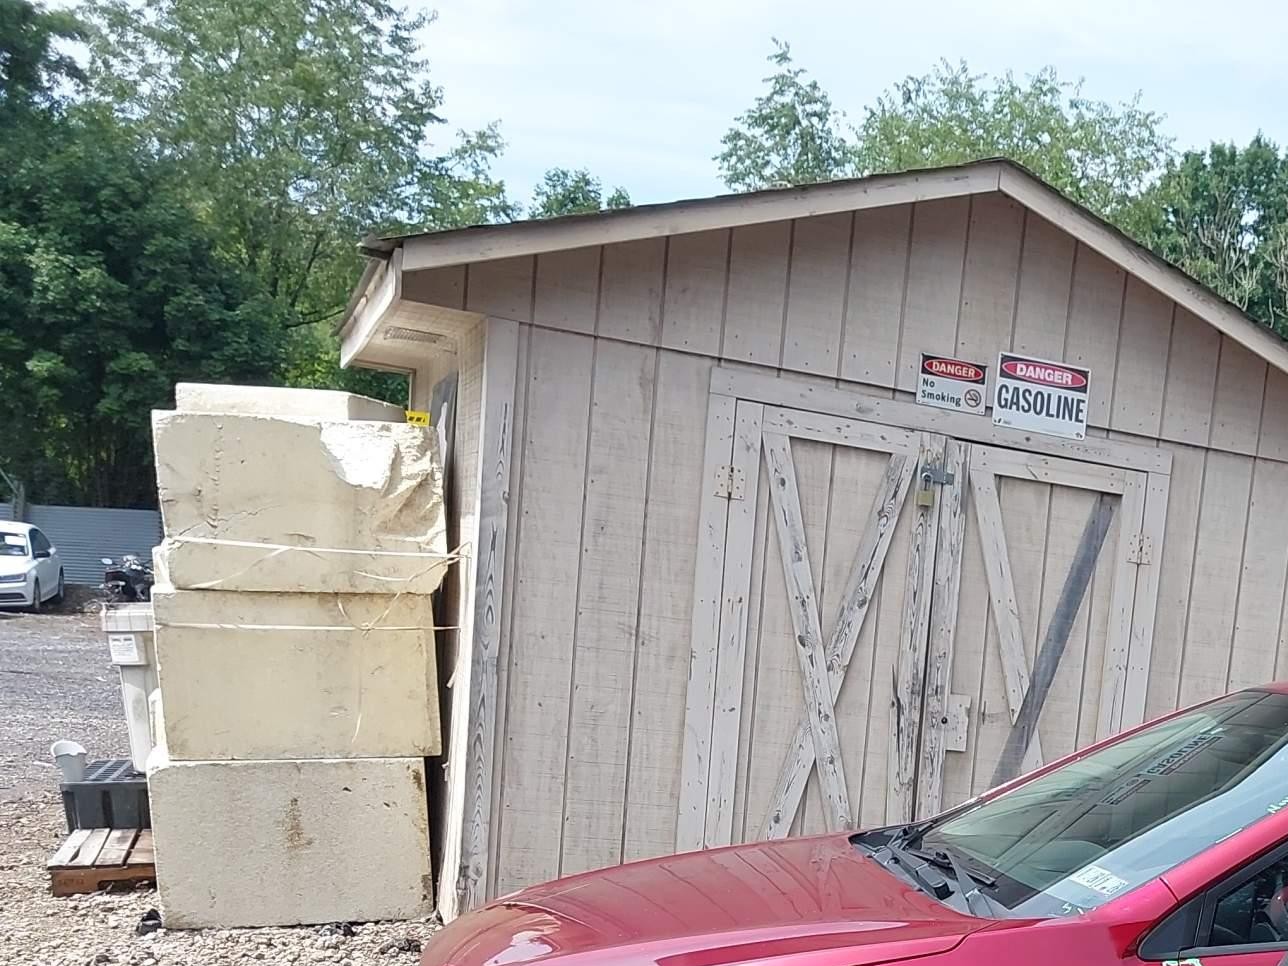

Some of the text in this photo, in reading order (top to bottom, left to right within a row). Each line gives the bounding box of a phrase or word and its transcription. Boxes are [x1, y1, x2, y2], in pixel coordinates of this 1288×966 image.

[932, 361, 976, 378] DANGER
[1016, 363, 1072, 385] DANGER
[922, 377, 935, 388] No
[921, 389, 961, 407] Smoking
[997, 383, 1086, 423] GASOLINE
